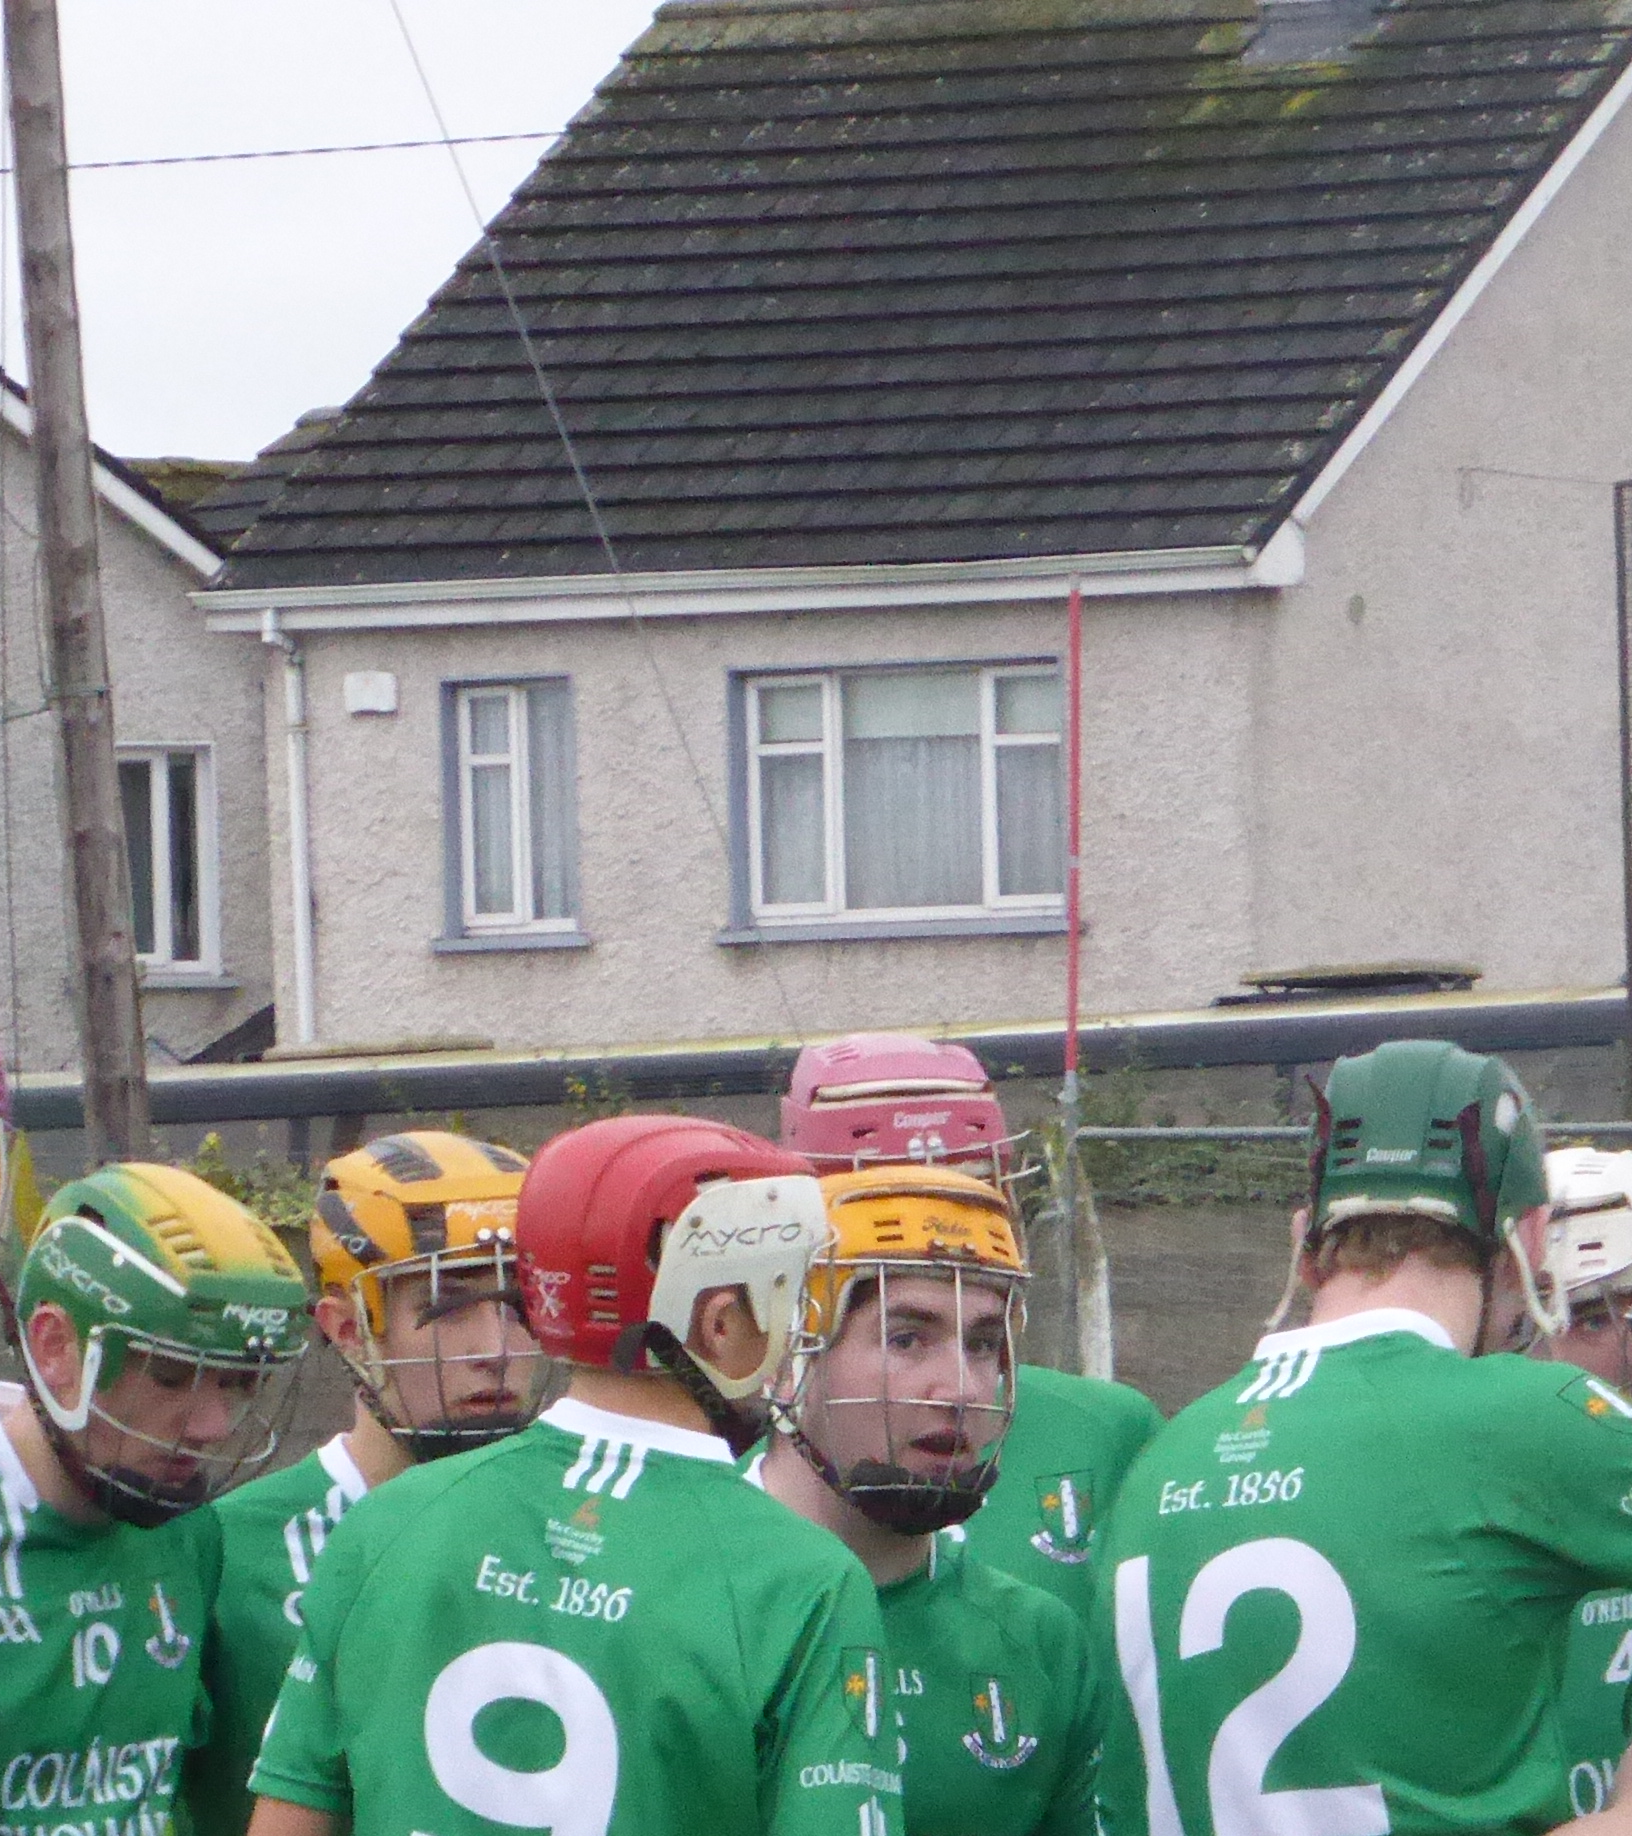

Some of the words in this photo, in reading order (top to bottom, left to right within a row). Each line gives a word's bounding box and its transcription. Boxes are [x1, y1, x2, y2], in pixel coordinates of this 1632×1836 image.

[1159, 1480, 1212, 1516] Est.
[1222, 1467, 1305, 1507] 1856
[475, 1554, 540, 1605] Est.
[549, 1576, 633, 1622] 1856
[72, 1622, 120, 1689] 10
